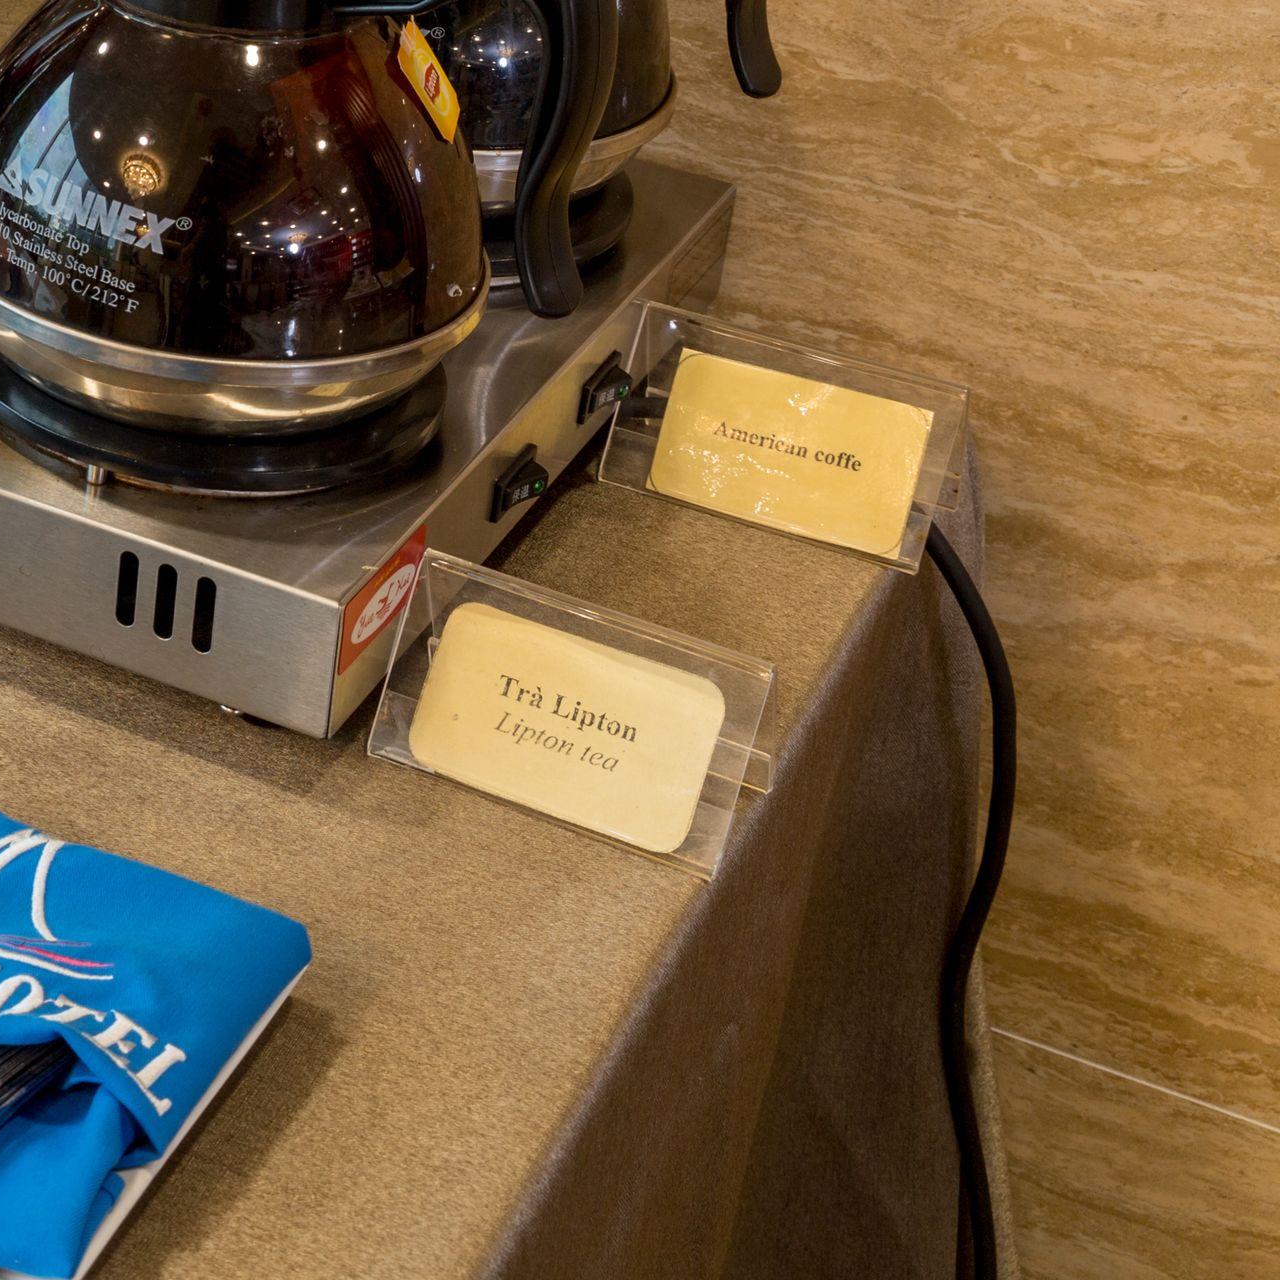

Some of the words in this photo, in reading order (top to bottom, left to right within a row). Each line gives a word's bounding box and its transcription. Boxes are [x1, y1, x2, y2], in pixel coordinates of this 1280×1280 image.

[6, 247, 38, 274] Temp.
[12, 231, 62, 265] Stainless
[65, 256, 98, 280] Steel
[100, 268, 135, 293] Base
[66, 234, 90, 256] Top
[713, 421, 808, 459] American
[813, 447, 863, 472] coffe
[499, 674, 545, 710] Trà
[552, 692, 639, 744] Lipton
[493, 711, 576, 763] Lipton
[579, 745, 620, 773] tea
